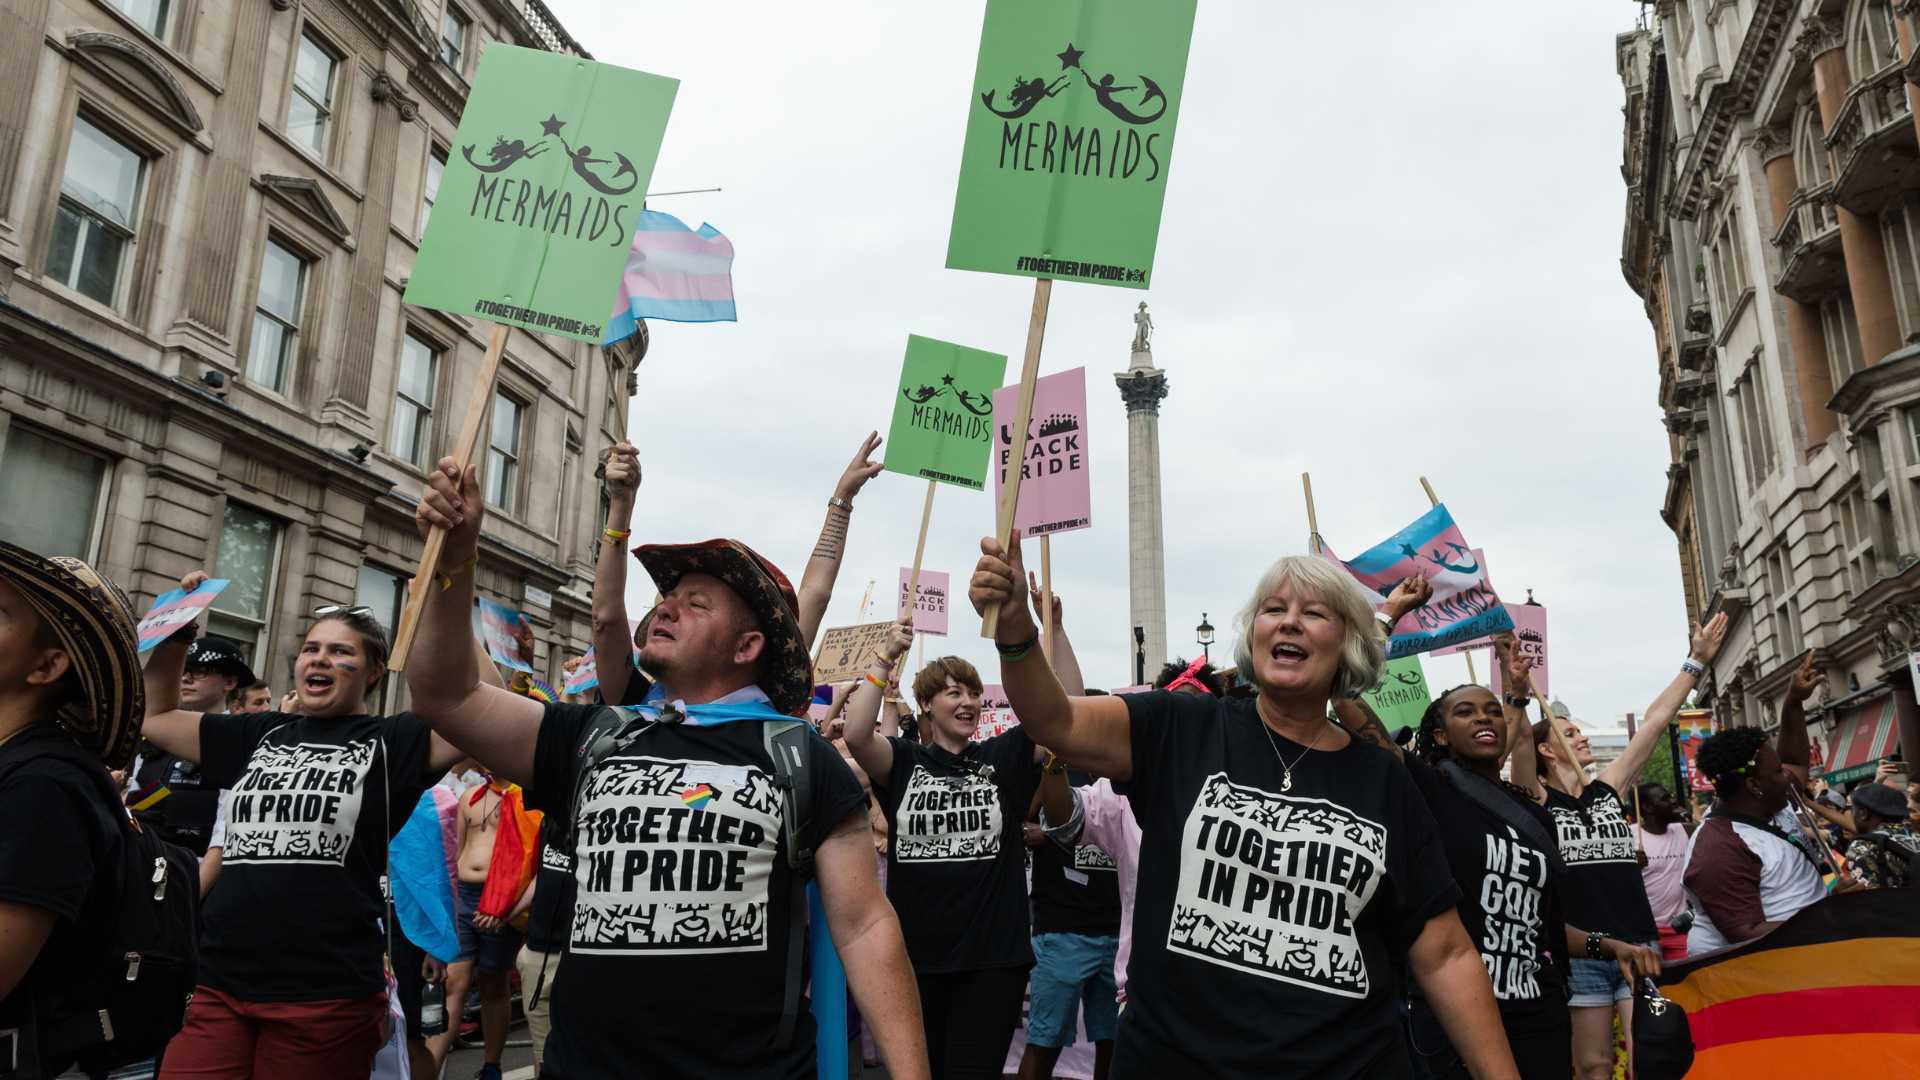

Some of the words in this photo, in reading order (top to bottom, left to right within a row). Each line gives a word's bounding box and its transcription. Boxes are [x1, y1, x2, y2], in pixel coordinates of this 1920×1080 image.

[999, 120, 1161, 182] MERMAIDS
[470, 173, 629, 247] MERMAIDS
[911, 403, 990, 443] MERMAIDS
[1001, 434, 1080, 465] BACK
[902, 593, 945, 605] BACK
[1412, 578, 1496, 630] ERMAIDS
[1374, 684, 1428, 709] MERMAIDS
[236, 766, 358, 795] TOGETHER
[907, 788, 995, 812] TOGETHER
[232, 794, 255, 824] IN
[258, 794, 342, 825] PRIDE
[586, 806, 766, 849] TOGETHER
[908, 813, 928, 836] IN
[932, 809, 992, 836] PRIDE
[1563, 826, 1582, 841] IN
[586, 850, 615, 892] IN
[622, 849, 749, 892] PRIDE
[1196, 814, 1375, 898] TOGETHER
[1485, 833, 1548, 888] MET
[1198, 858, 1238, 908] IN
[1242, 871, 1353, 937] PRIDE
